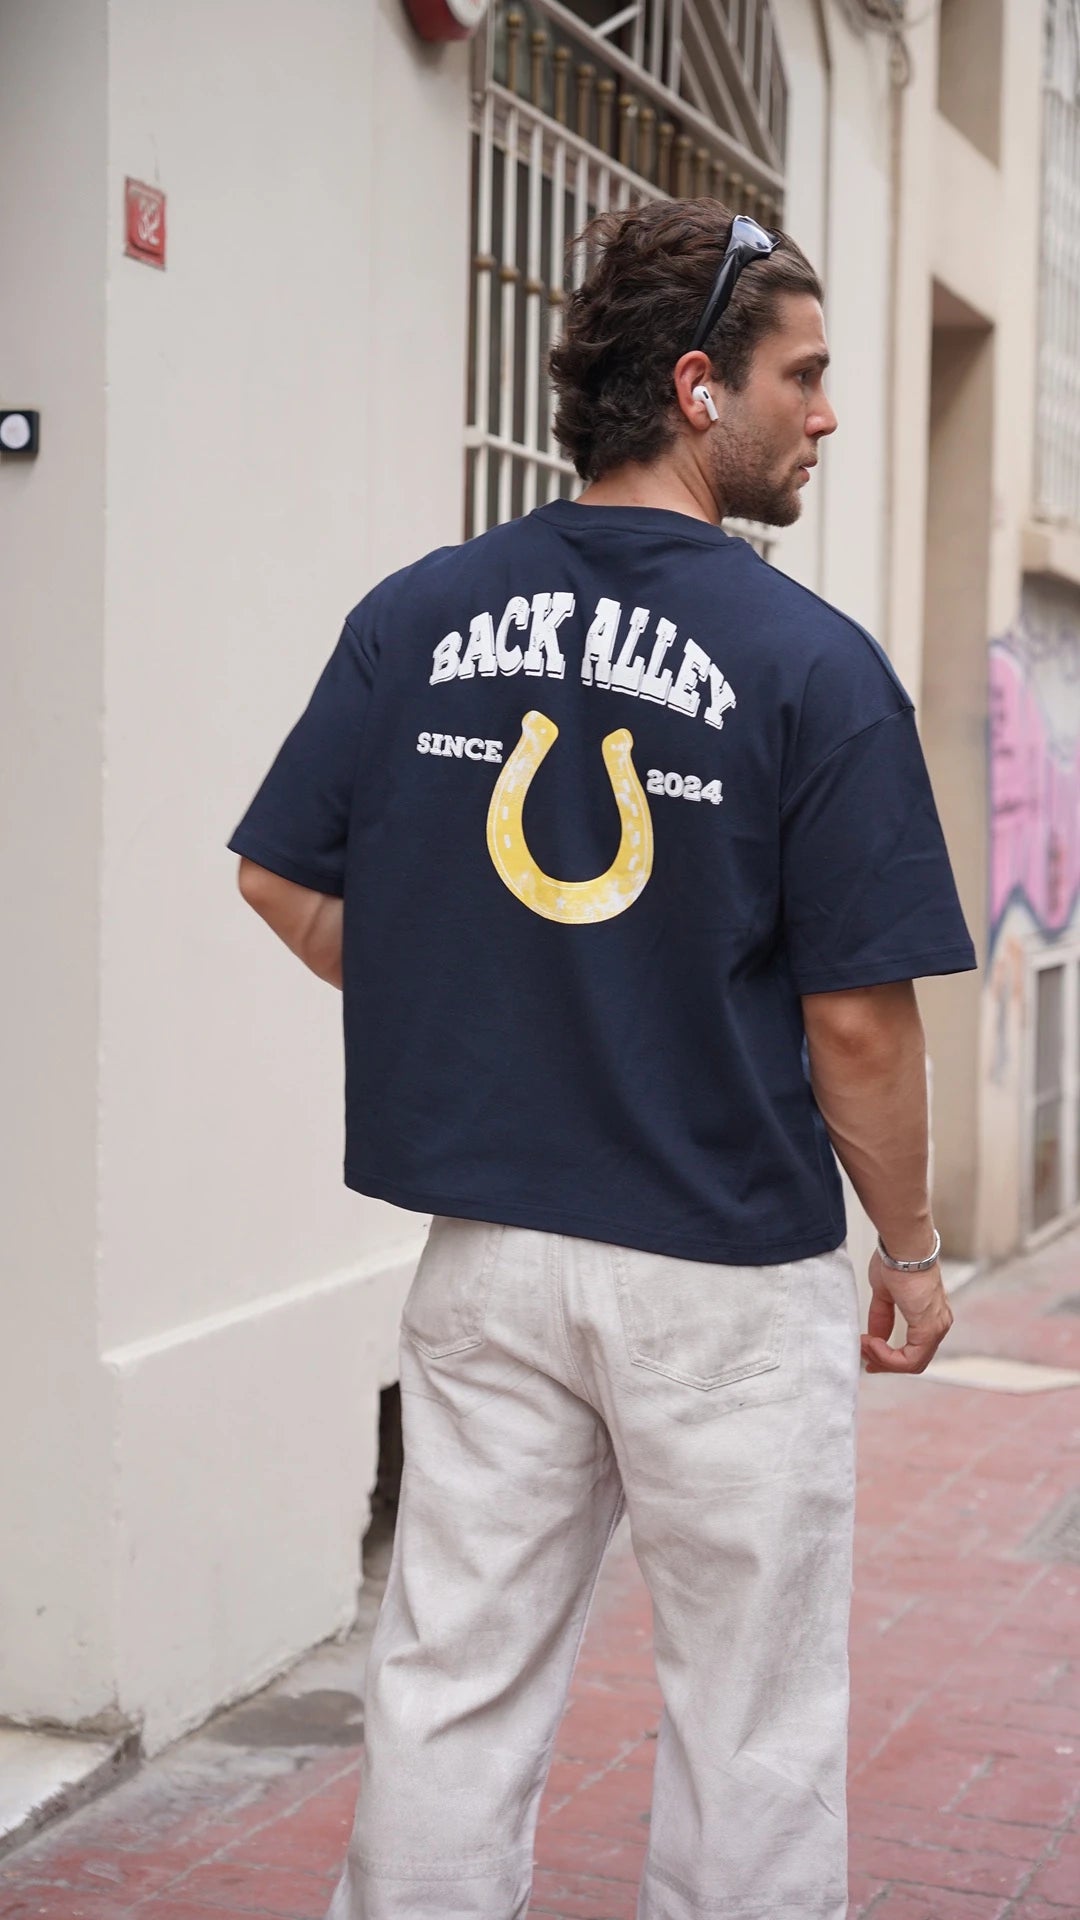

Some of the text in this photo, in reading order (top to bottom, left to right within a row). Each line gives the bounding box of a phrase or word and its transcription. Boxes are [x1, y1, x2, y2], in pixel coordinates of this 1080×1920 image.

[429, 591, 737, 730] BACK ALLEY
[416, 731, 723, 805] SINCE 2024
